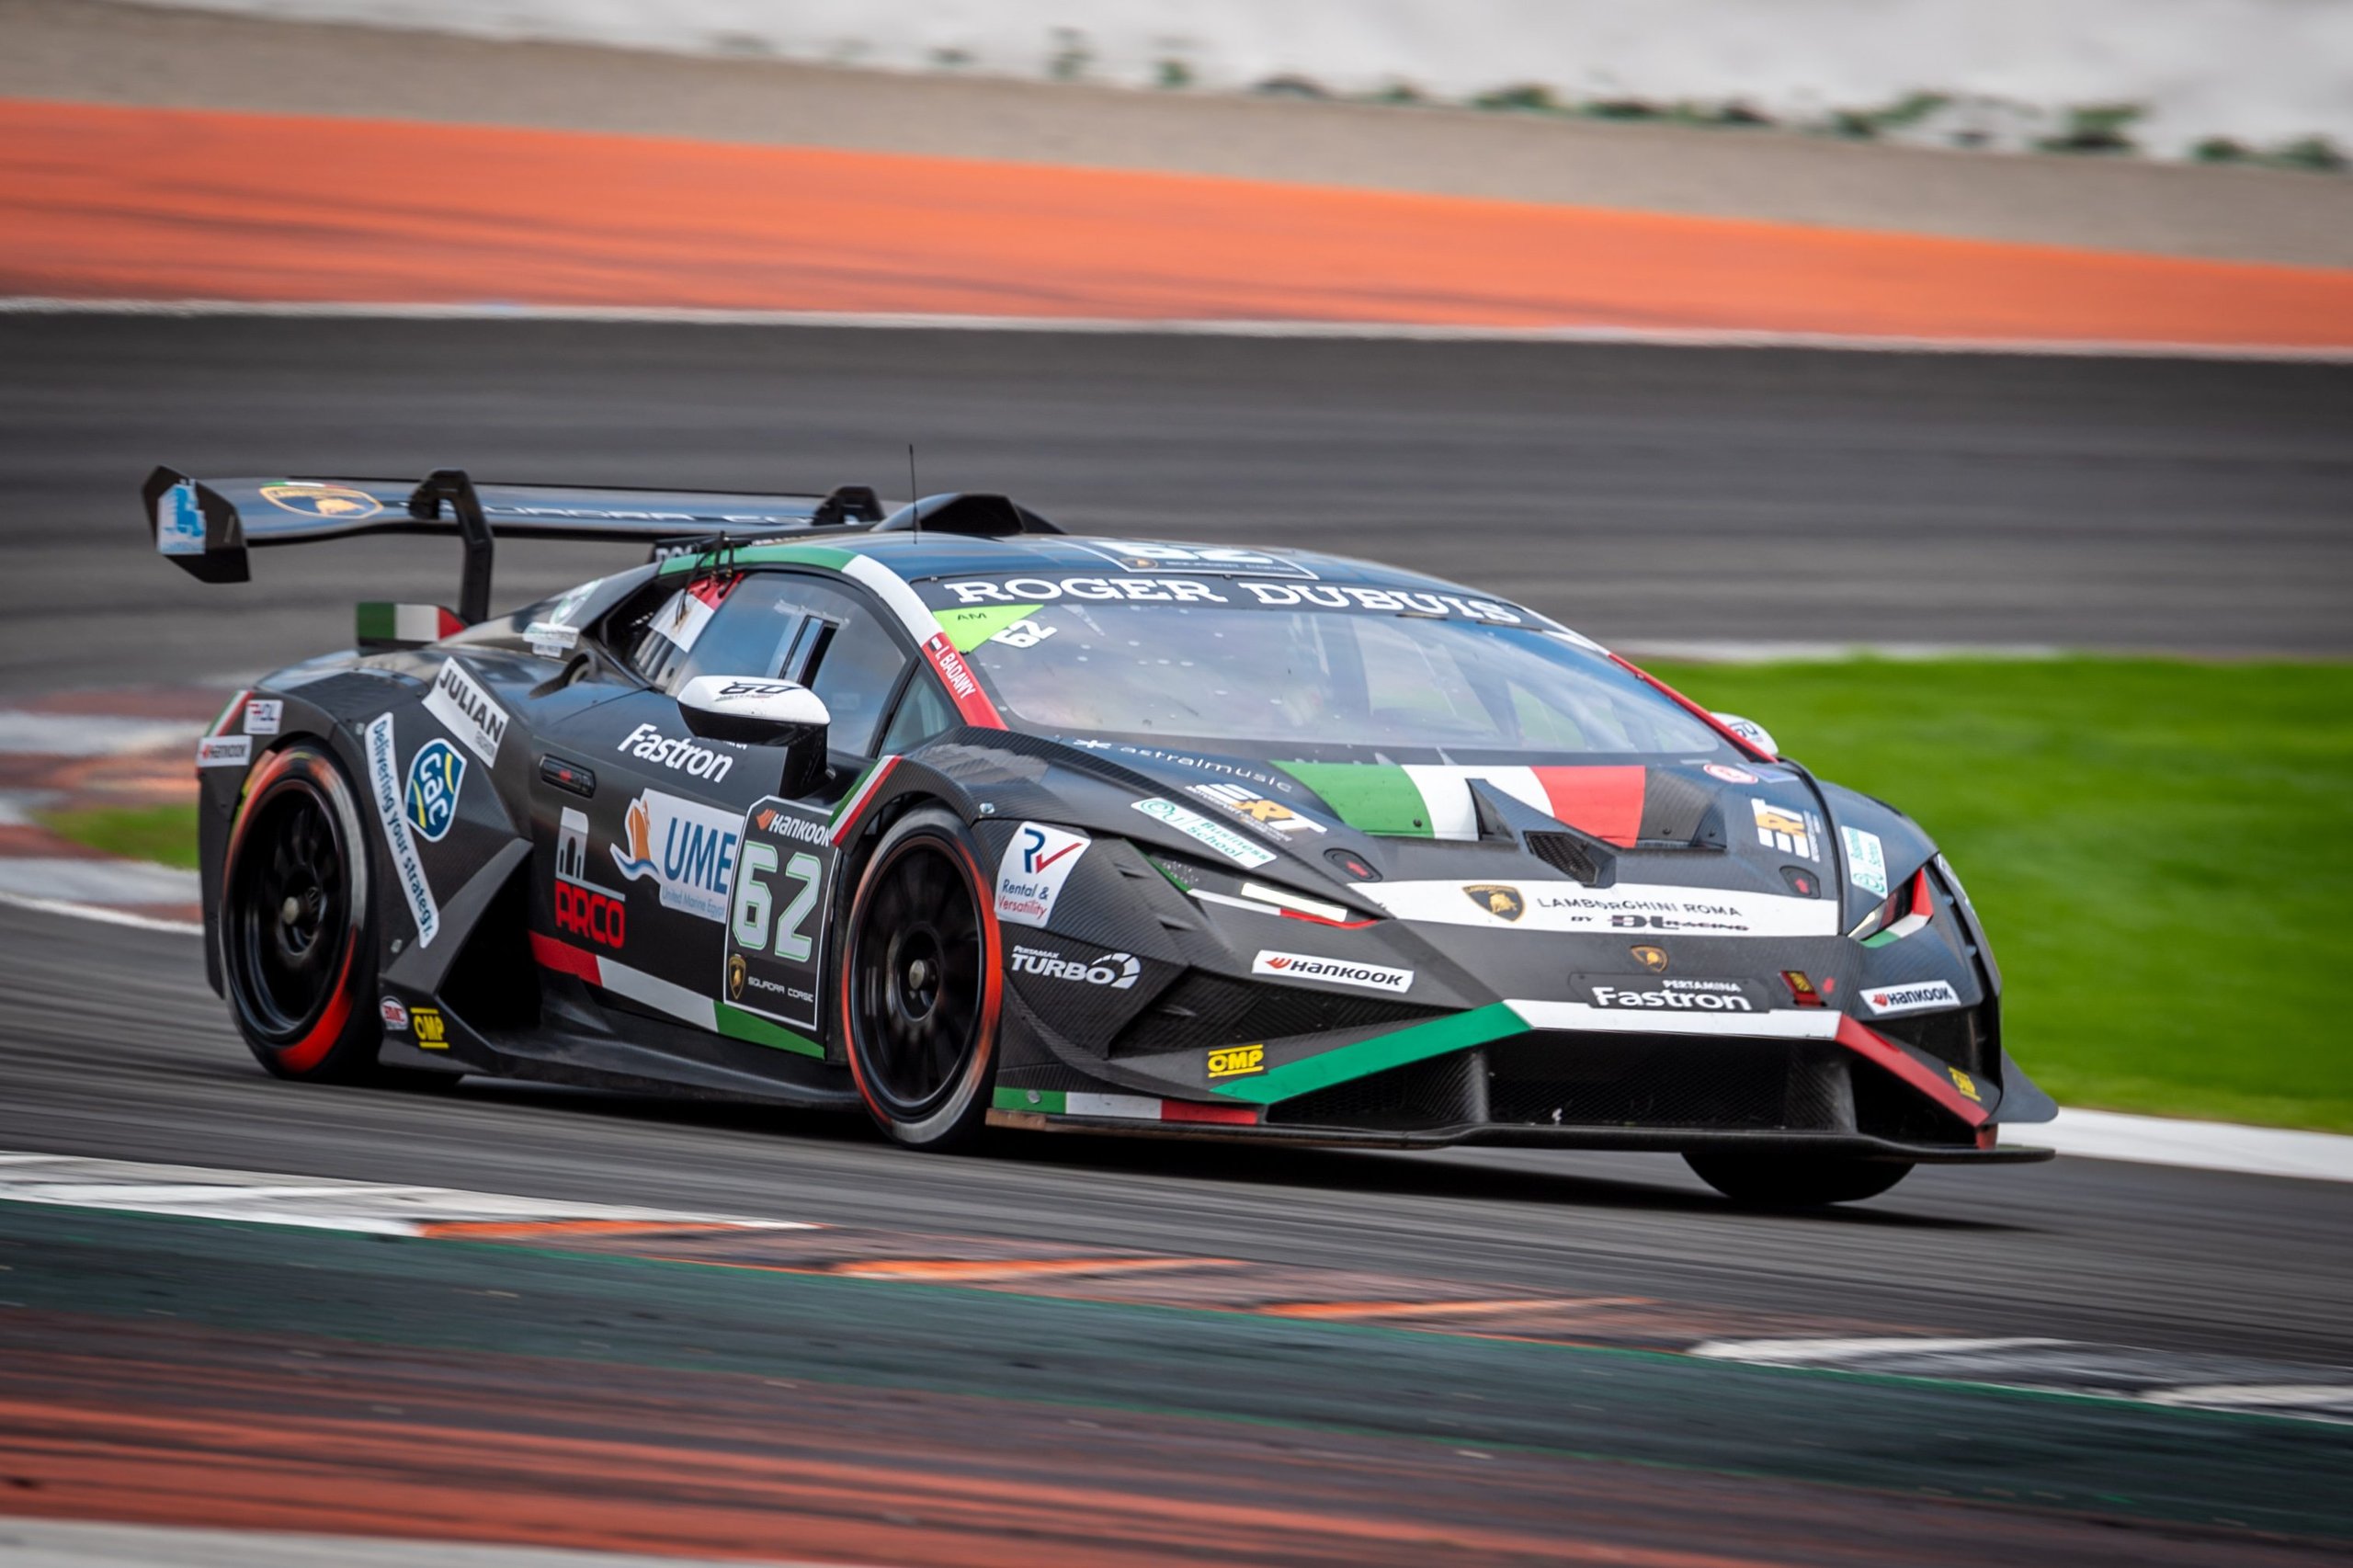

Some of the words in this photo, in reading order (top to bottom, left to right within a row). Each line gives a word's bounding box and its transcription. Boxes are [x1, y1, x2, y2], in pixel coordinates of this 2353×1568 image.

[945, 578, 1229, 603] ROGER
[1239, 582, 1521, 622] DUBUIS
[957, 612, 987, 621] AM
[989, 619, 1058, 648] 62
[939, 653, 976, 699] BADAWY
[439, 669, 504, 744] JULIAN
[617, 723, 733, 783] Fastron
[1120, 746, 1292, 793] astralmusic
[373, 720, 396, 812] Delivering
[387, 807, 409, 855] your
[664, 817, 737, 895] UME
[1187, 826, 1244, 858] School
[1200, 822, 1269, 860] Business
[732, 839, 822, 963] 62
[1002, 879, 1039, 898] Rental
[1038, 886, 1050, 901] &
[554, 880, 625, 949] ARCO
[998, 895, 1048, 919] Versatility
[1537, 897, 1677, 912] LAMBORGHINI
[1683, 903, 1744, 917] ROMA
[1012, 953, 1116, 985] TURBO
[748, 975, 786, 995] SQUADRA
[788, 986, 814, 1003] CORSE
[1591, 986, 1753, 1011] Fastron
[1662, 980, 1743, 993] PERTAMINA
[414, 1015, 445, 1041] OMP
[1208, 1050, 1265, 1073] OMP
